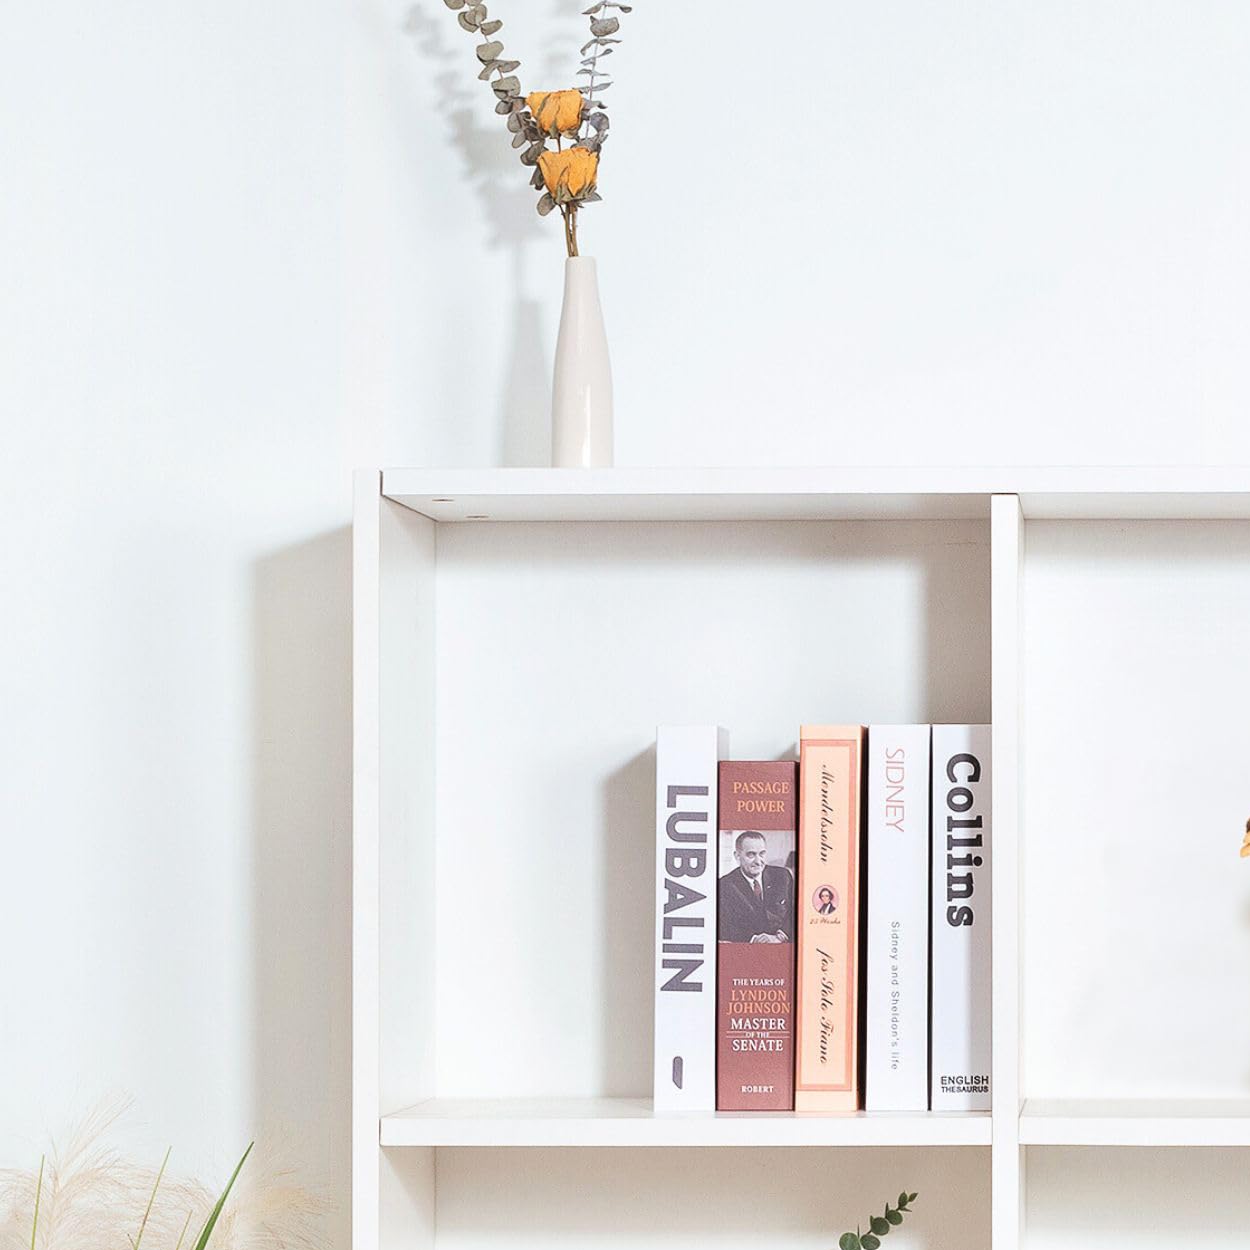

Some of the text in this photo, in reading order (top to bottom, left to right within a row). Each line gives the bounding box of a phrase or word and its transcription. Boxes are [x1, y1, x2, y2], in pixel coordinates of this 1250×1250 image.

[733, 782, 789, 793] PASSAGE
[886, 747, 905, 833] SIDNEY
[737, 800, 785, 812] POWER
[819, 764, 834, 863] Mendelssohn
[946, 752, 983, 928] Collins
[660, 785, 709, 992] LUBALIN
[733, 978, 785, 986] THE YEARS OF
[731, 989, 787, 1001] LYNDON
[889, 921, 900, 1070] Sidney and Sheldon's life
[726, 1002, 791, 1015] JOHNSON
[730, 1018, 786, 1030] MASTER
[732, 1040, 784, 1051] SENATE
[940, 1075, 989, 1085] ENGLISH
[741, 1085, 774, 1093] ROBERT
